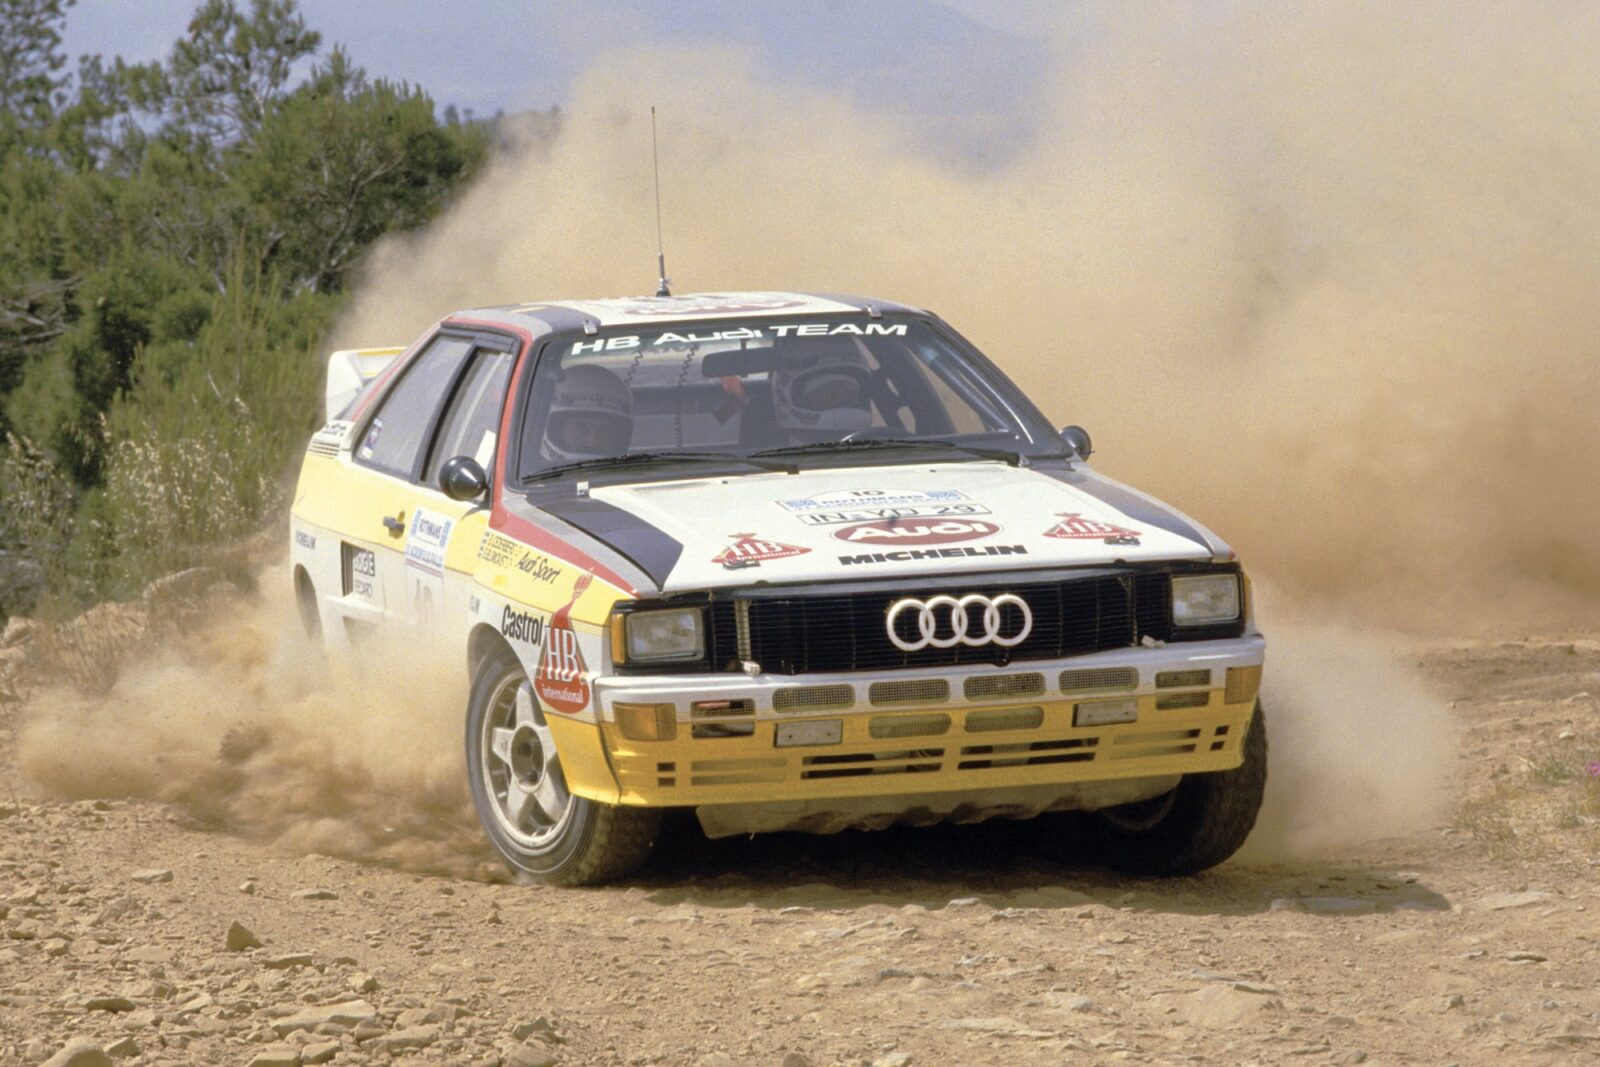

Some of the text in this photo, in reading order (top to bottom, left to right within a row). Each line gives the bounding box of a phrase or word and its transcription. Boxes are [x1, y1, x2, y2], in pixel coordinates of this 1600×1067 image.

[571, 335, 641, 355] HB
[769, 323, 908, 337] TEAM
[1059, 521, 1113, 533] HB
[730, 541, 784, 556] HB
[838, 544, 1029, 566] MICHELIN
[515, 551, 541, 573] Audi
[532, 558, 561, 585] Sport
[501, 603, 545, 647] Castrol
[544, 624, 580, 682] HB
[541, 683, 584, 704] international
